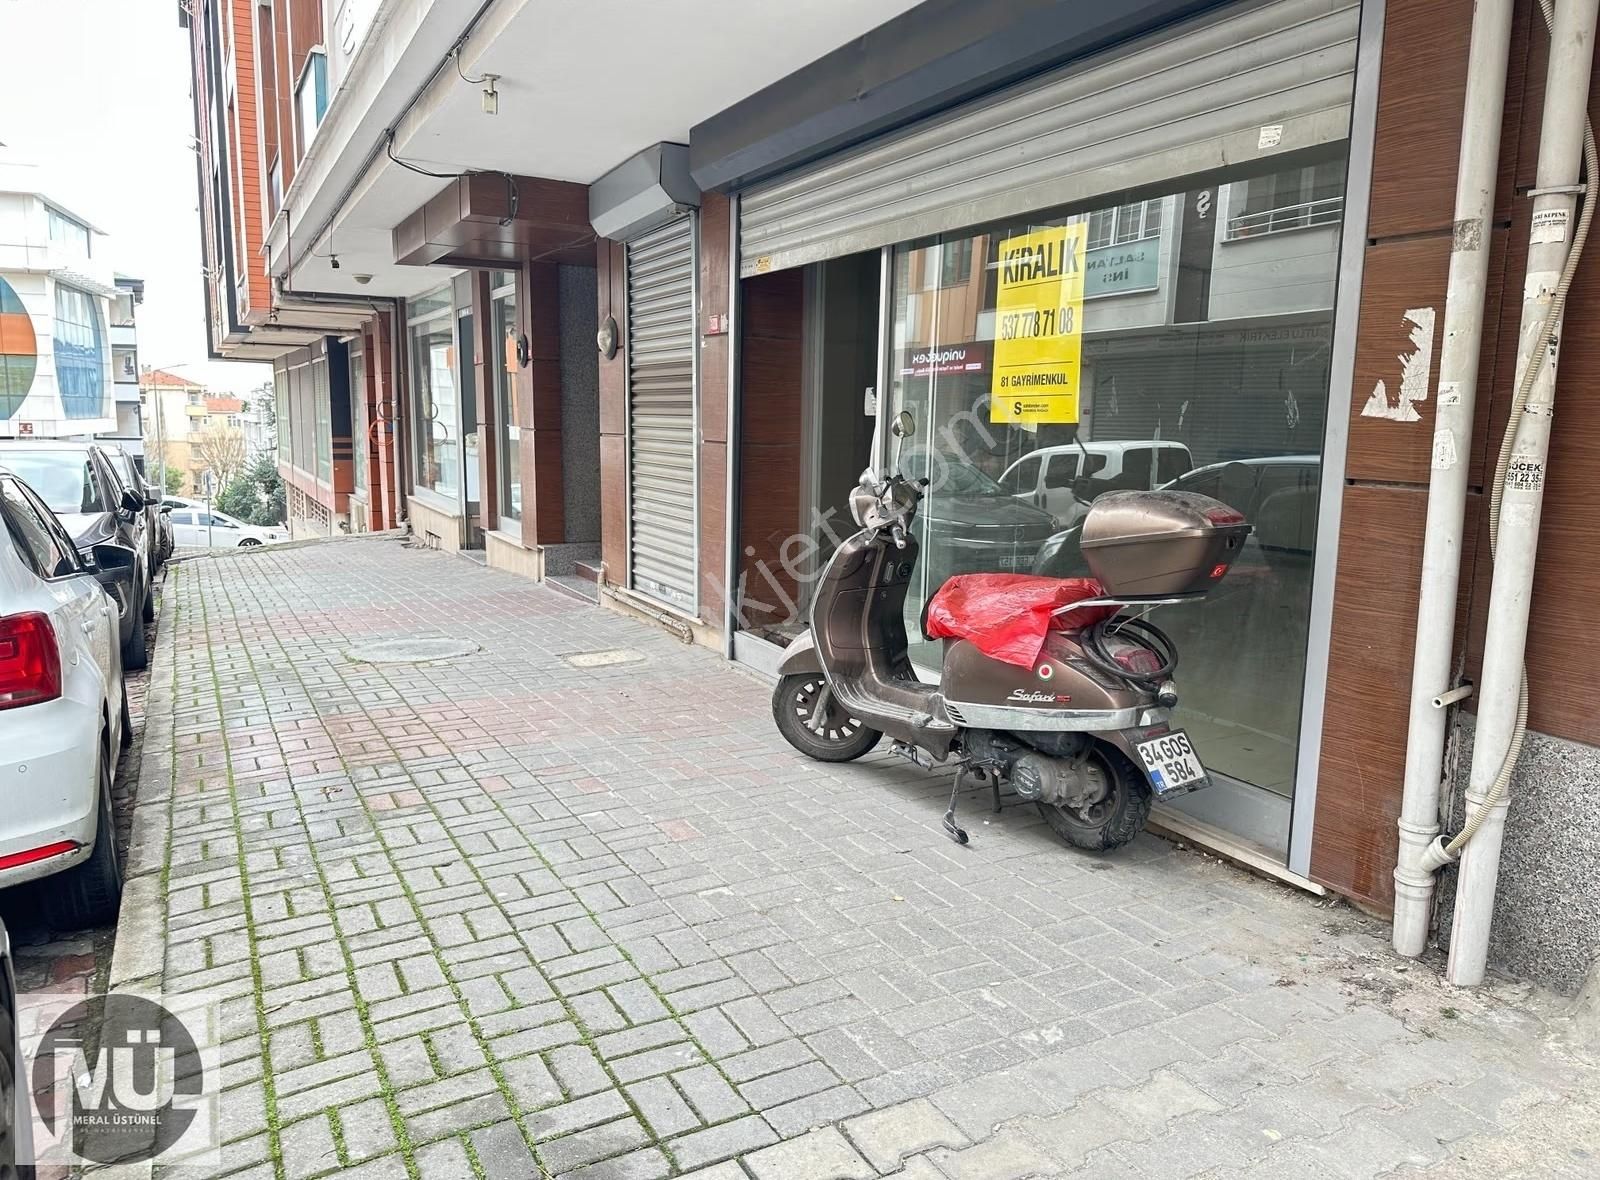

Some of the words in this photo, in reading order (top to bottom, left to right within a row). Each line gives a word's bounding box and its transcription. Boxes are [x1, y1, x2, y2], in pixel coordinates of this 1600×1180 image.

[1001, 309, 1019, 341] 537
[1021, 309, 1040, 339] 778
[1042, 308, 1055, 336] 71
[1058, 307, 1073, 334] 08
[1000, 376, 1009, 388] 81
[1011, 373, 1068, 387] GAYRİMENKUL
[1007, 688, 1057, 702] Safari
[1163, 757, 1196, 783] 584
